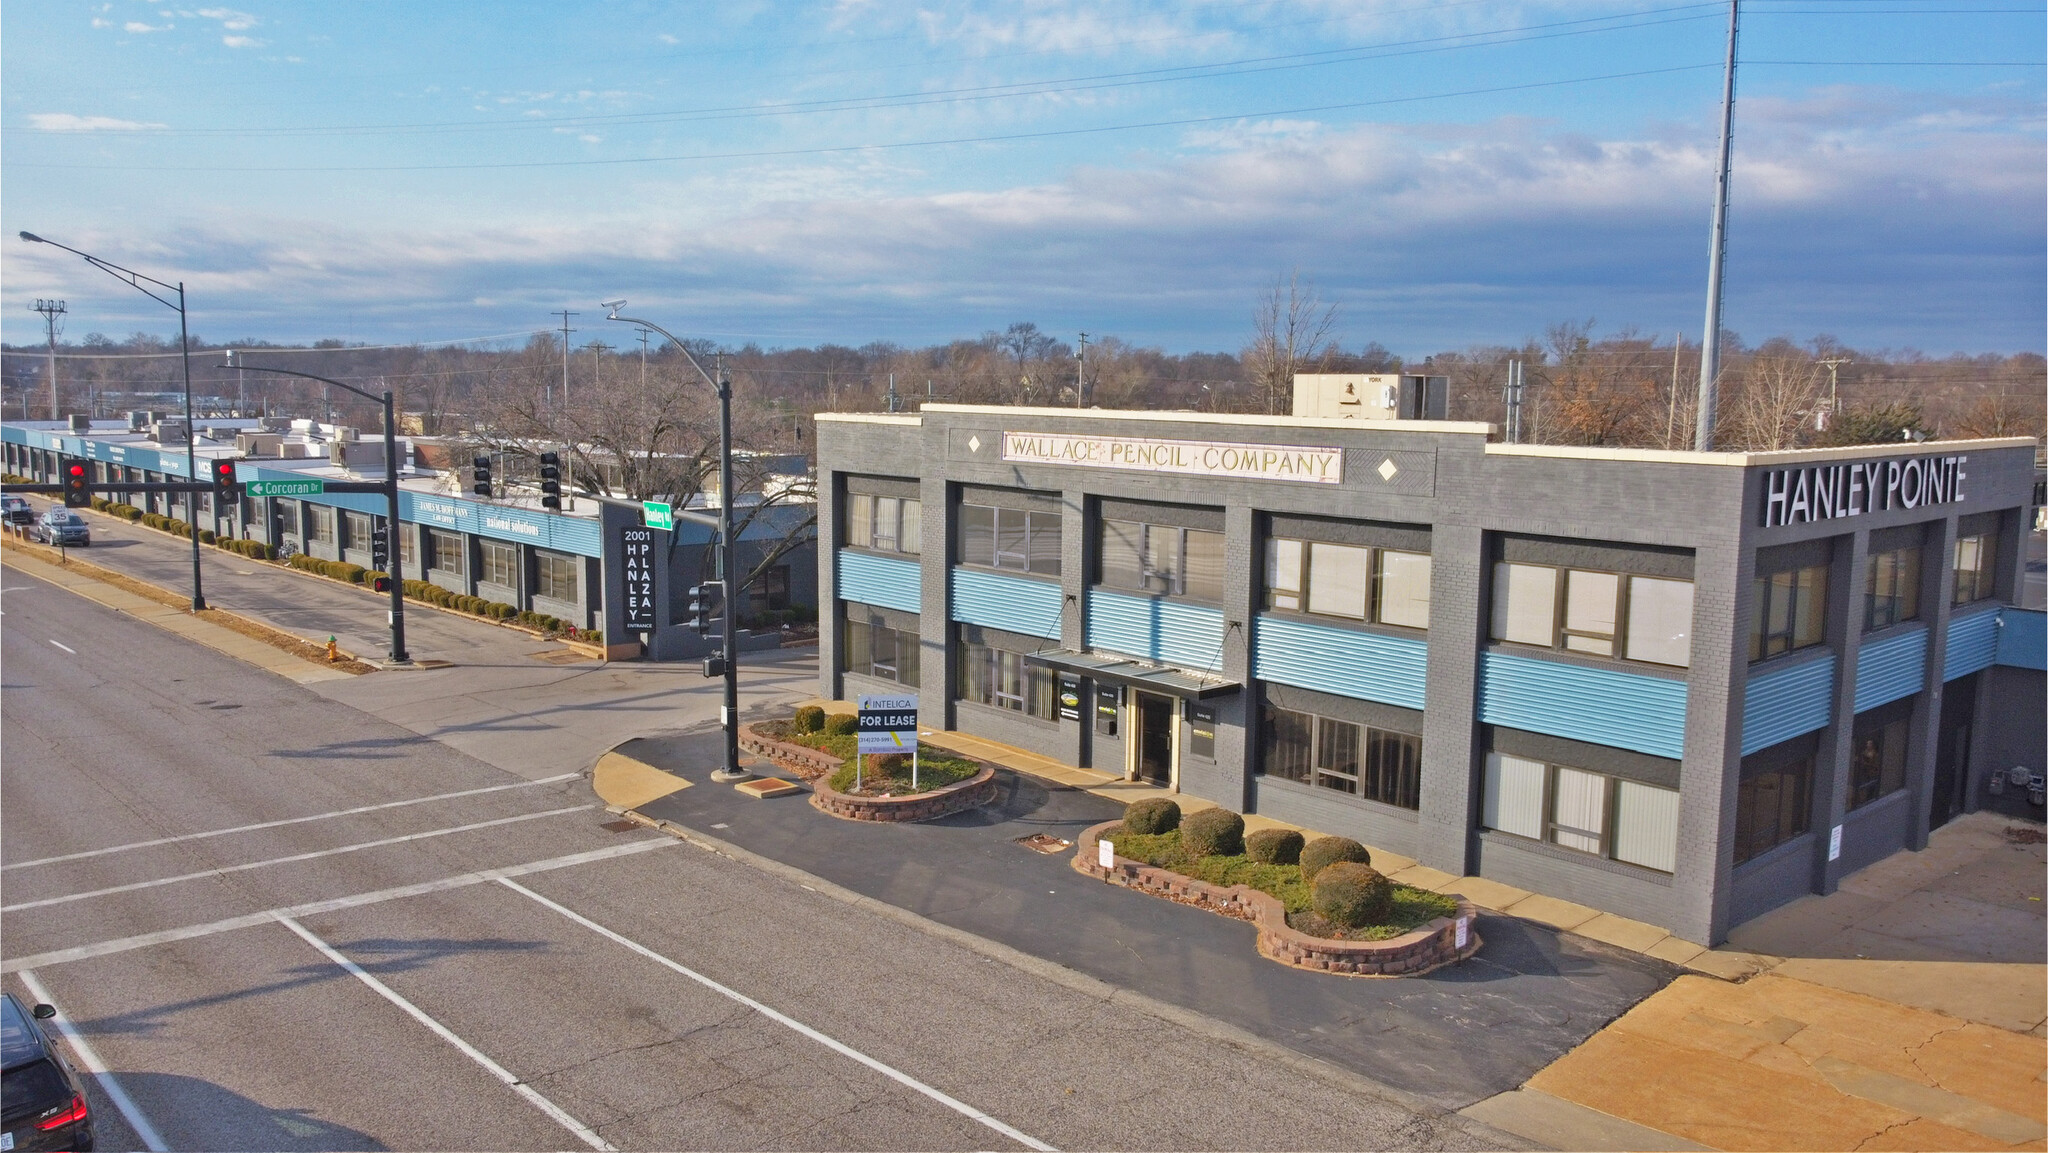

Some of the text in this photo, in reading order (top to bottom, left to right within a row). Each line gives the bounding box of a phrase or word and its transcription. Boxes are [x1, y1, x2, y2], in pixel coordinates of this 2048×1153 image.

[1011, 437, 1333, 477] WALLACE PENCIL COMPANY
[265, 482, 319, 494] Corcoran Dr
[1765, 455, 1968, 529] HANLEY POINTE
[486, 515, 539, 536] national solutions
[624, 531, 651, 541] 2001
[627, 544, 638, 621] HANLEY
[641, 544, 652, 608] PLAZA
[872, 700, 911, 708] INTELICA
[860, 715, 916, 727] FOR LEASE
